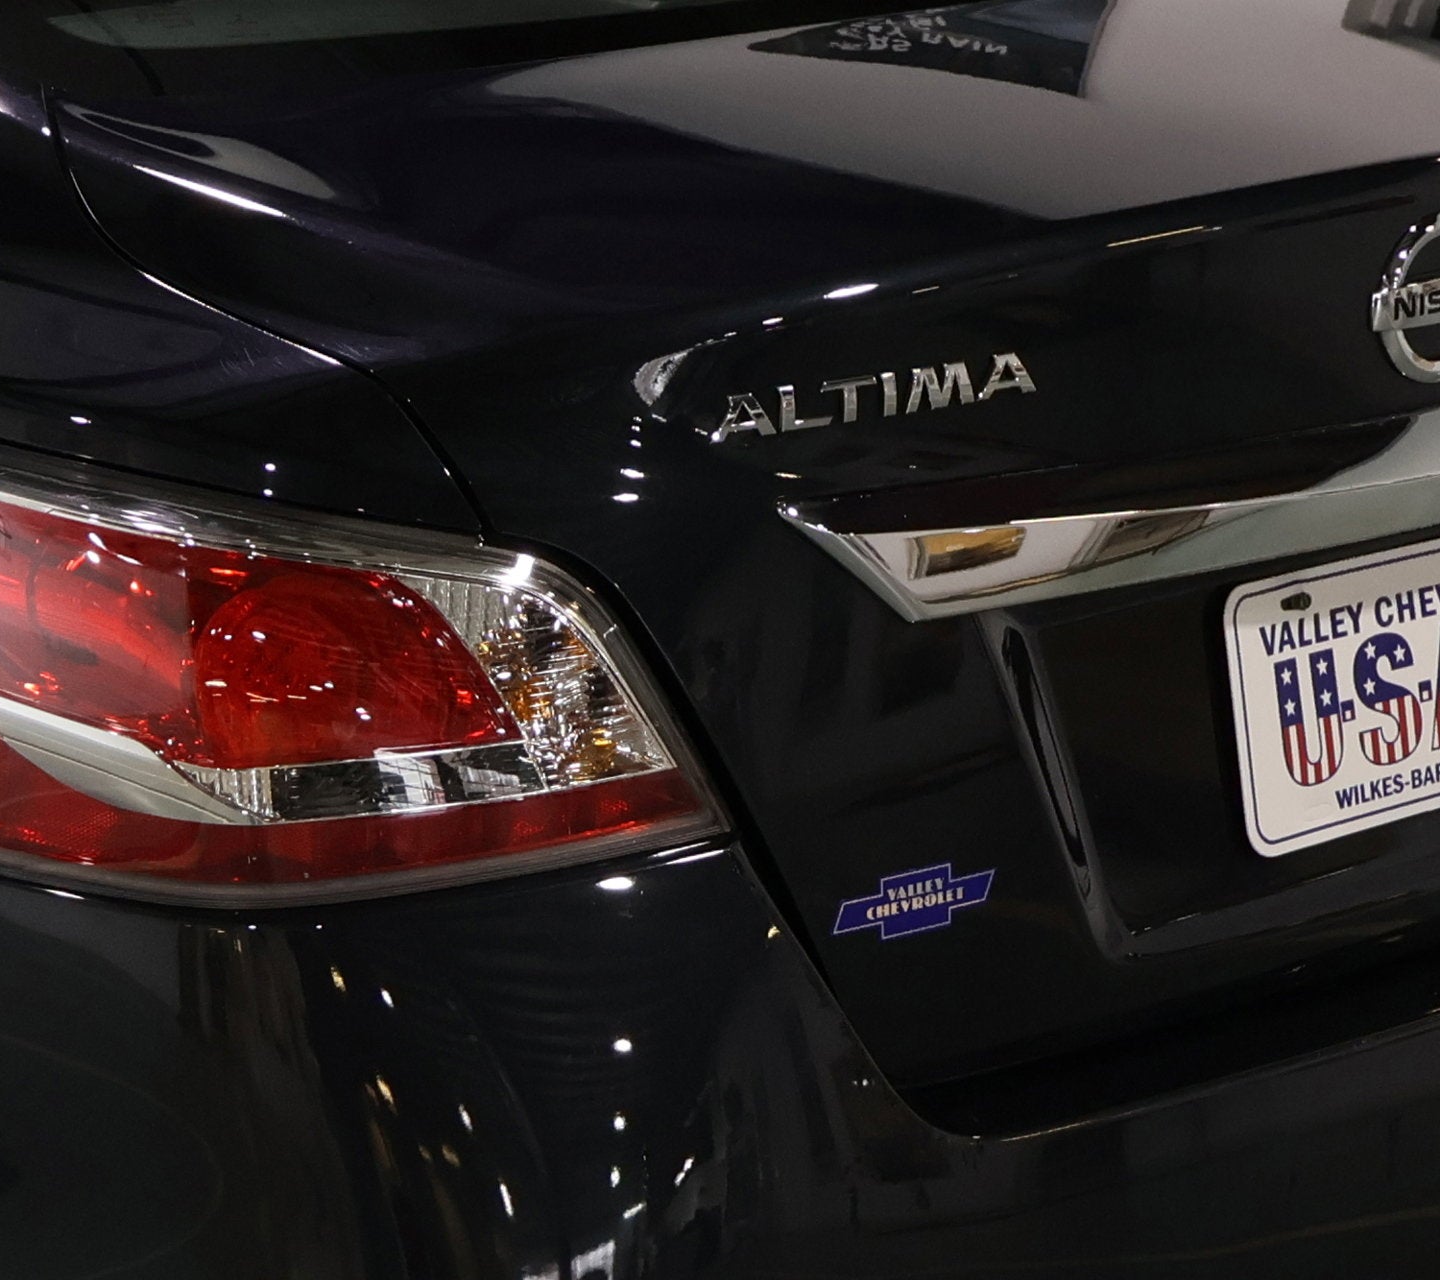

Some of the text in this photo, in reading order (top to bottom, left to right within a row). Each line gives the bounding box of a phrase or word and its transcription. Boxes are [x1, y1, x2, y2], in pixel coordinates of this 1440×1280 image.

[709, 351, 1037, 445] ALTIMA
[1258, 602, 1364, 657] VALLEY
[866, 886, 965, 920] CHEVROLET
[887, 877, 944, 902] VALLEY
